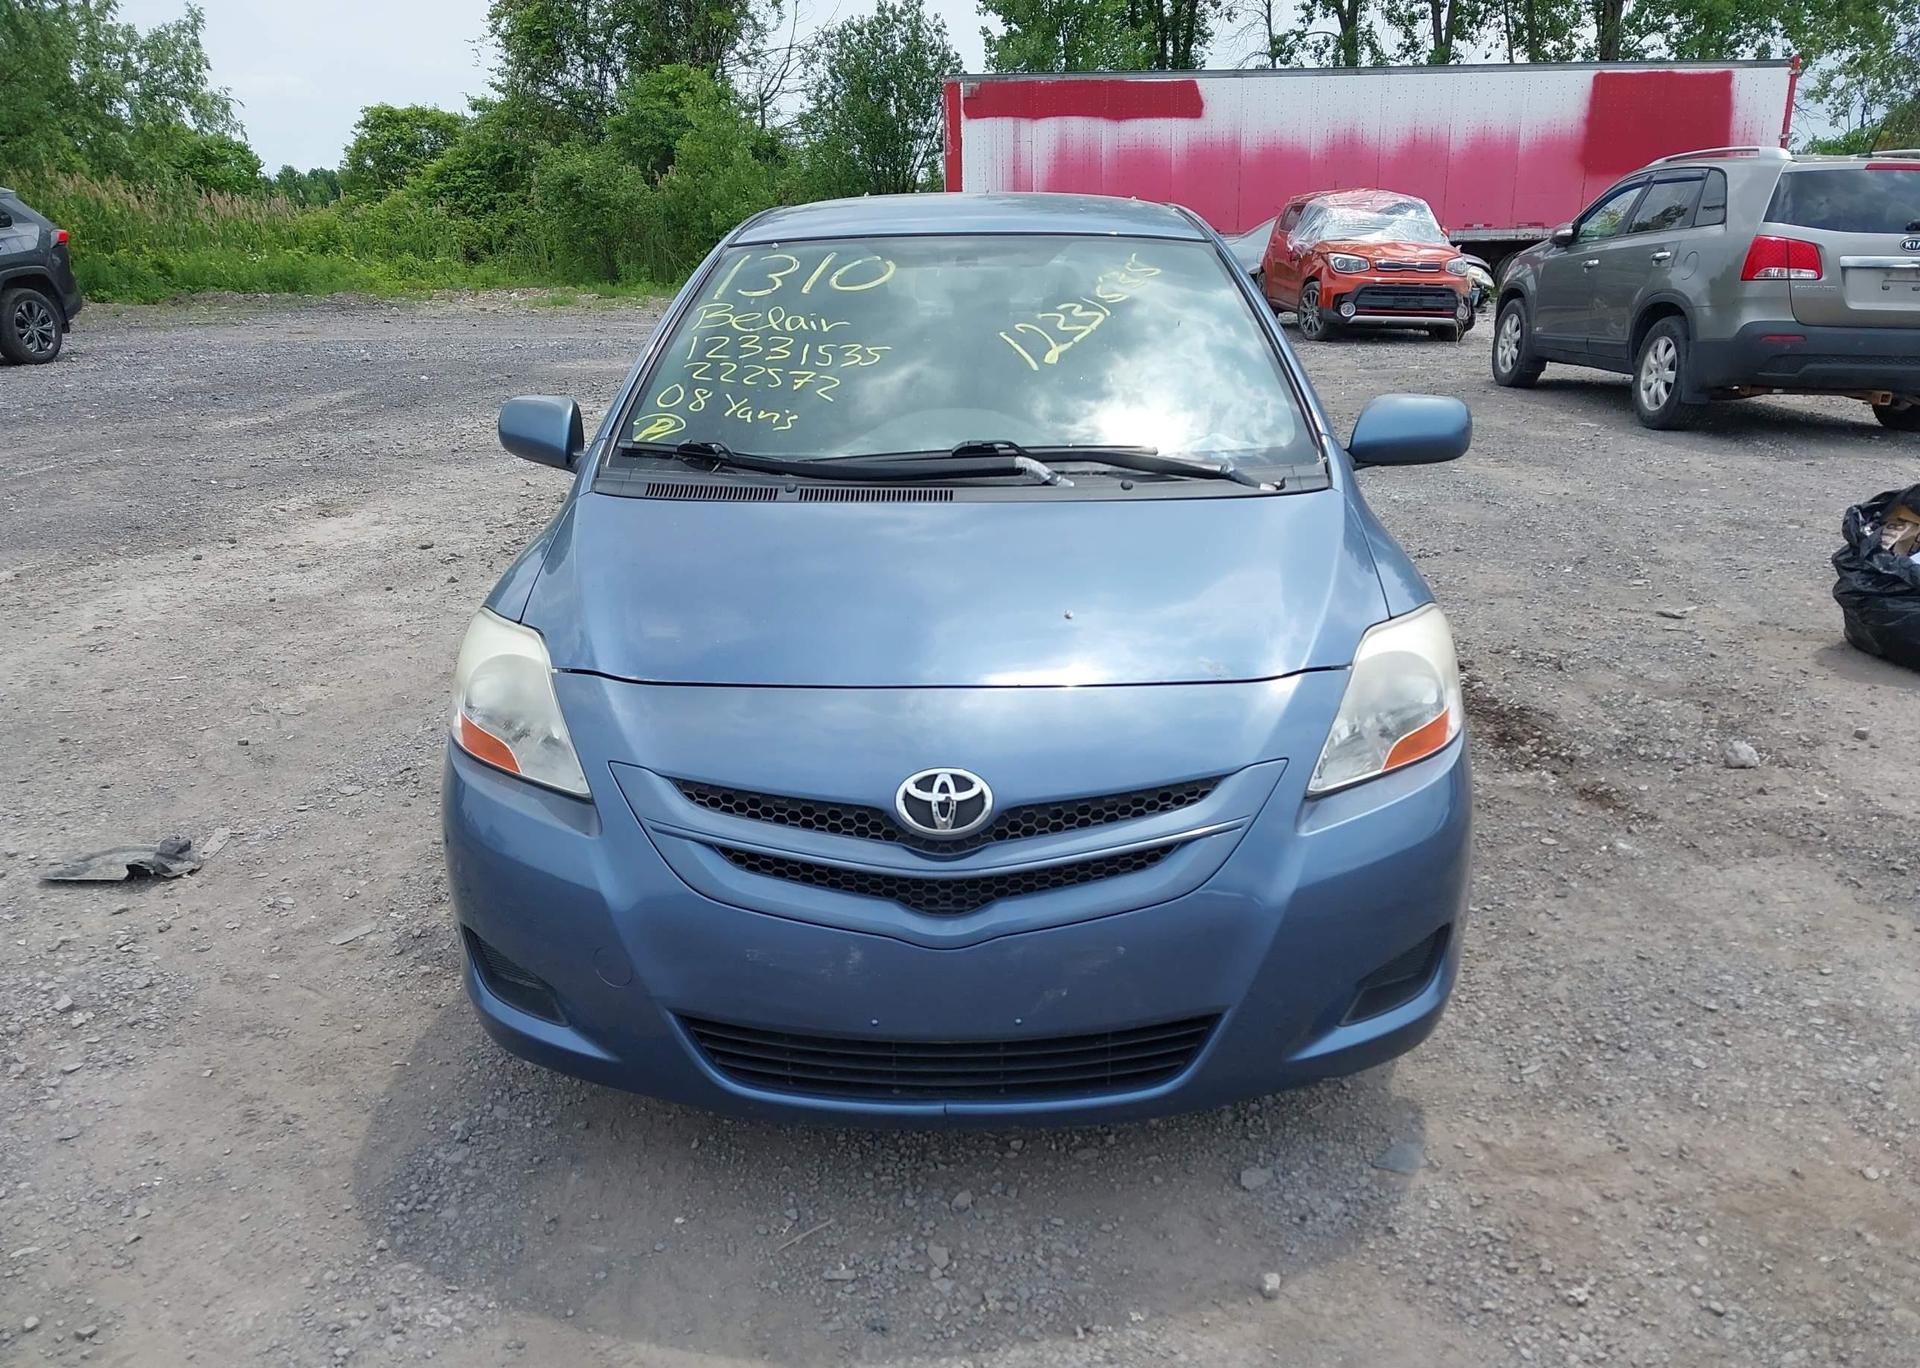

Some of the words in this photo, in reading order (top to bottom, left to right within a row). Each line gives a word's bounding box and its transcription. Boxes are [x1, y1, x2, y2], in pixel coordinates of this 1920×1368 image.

[712, 252, 897, 299] 1310
[686, 336, 892, 367] 12331535
[656, 383, 713, 412] 08
[683, 362, 841, 402] 222572
